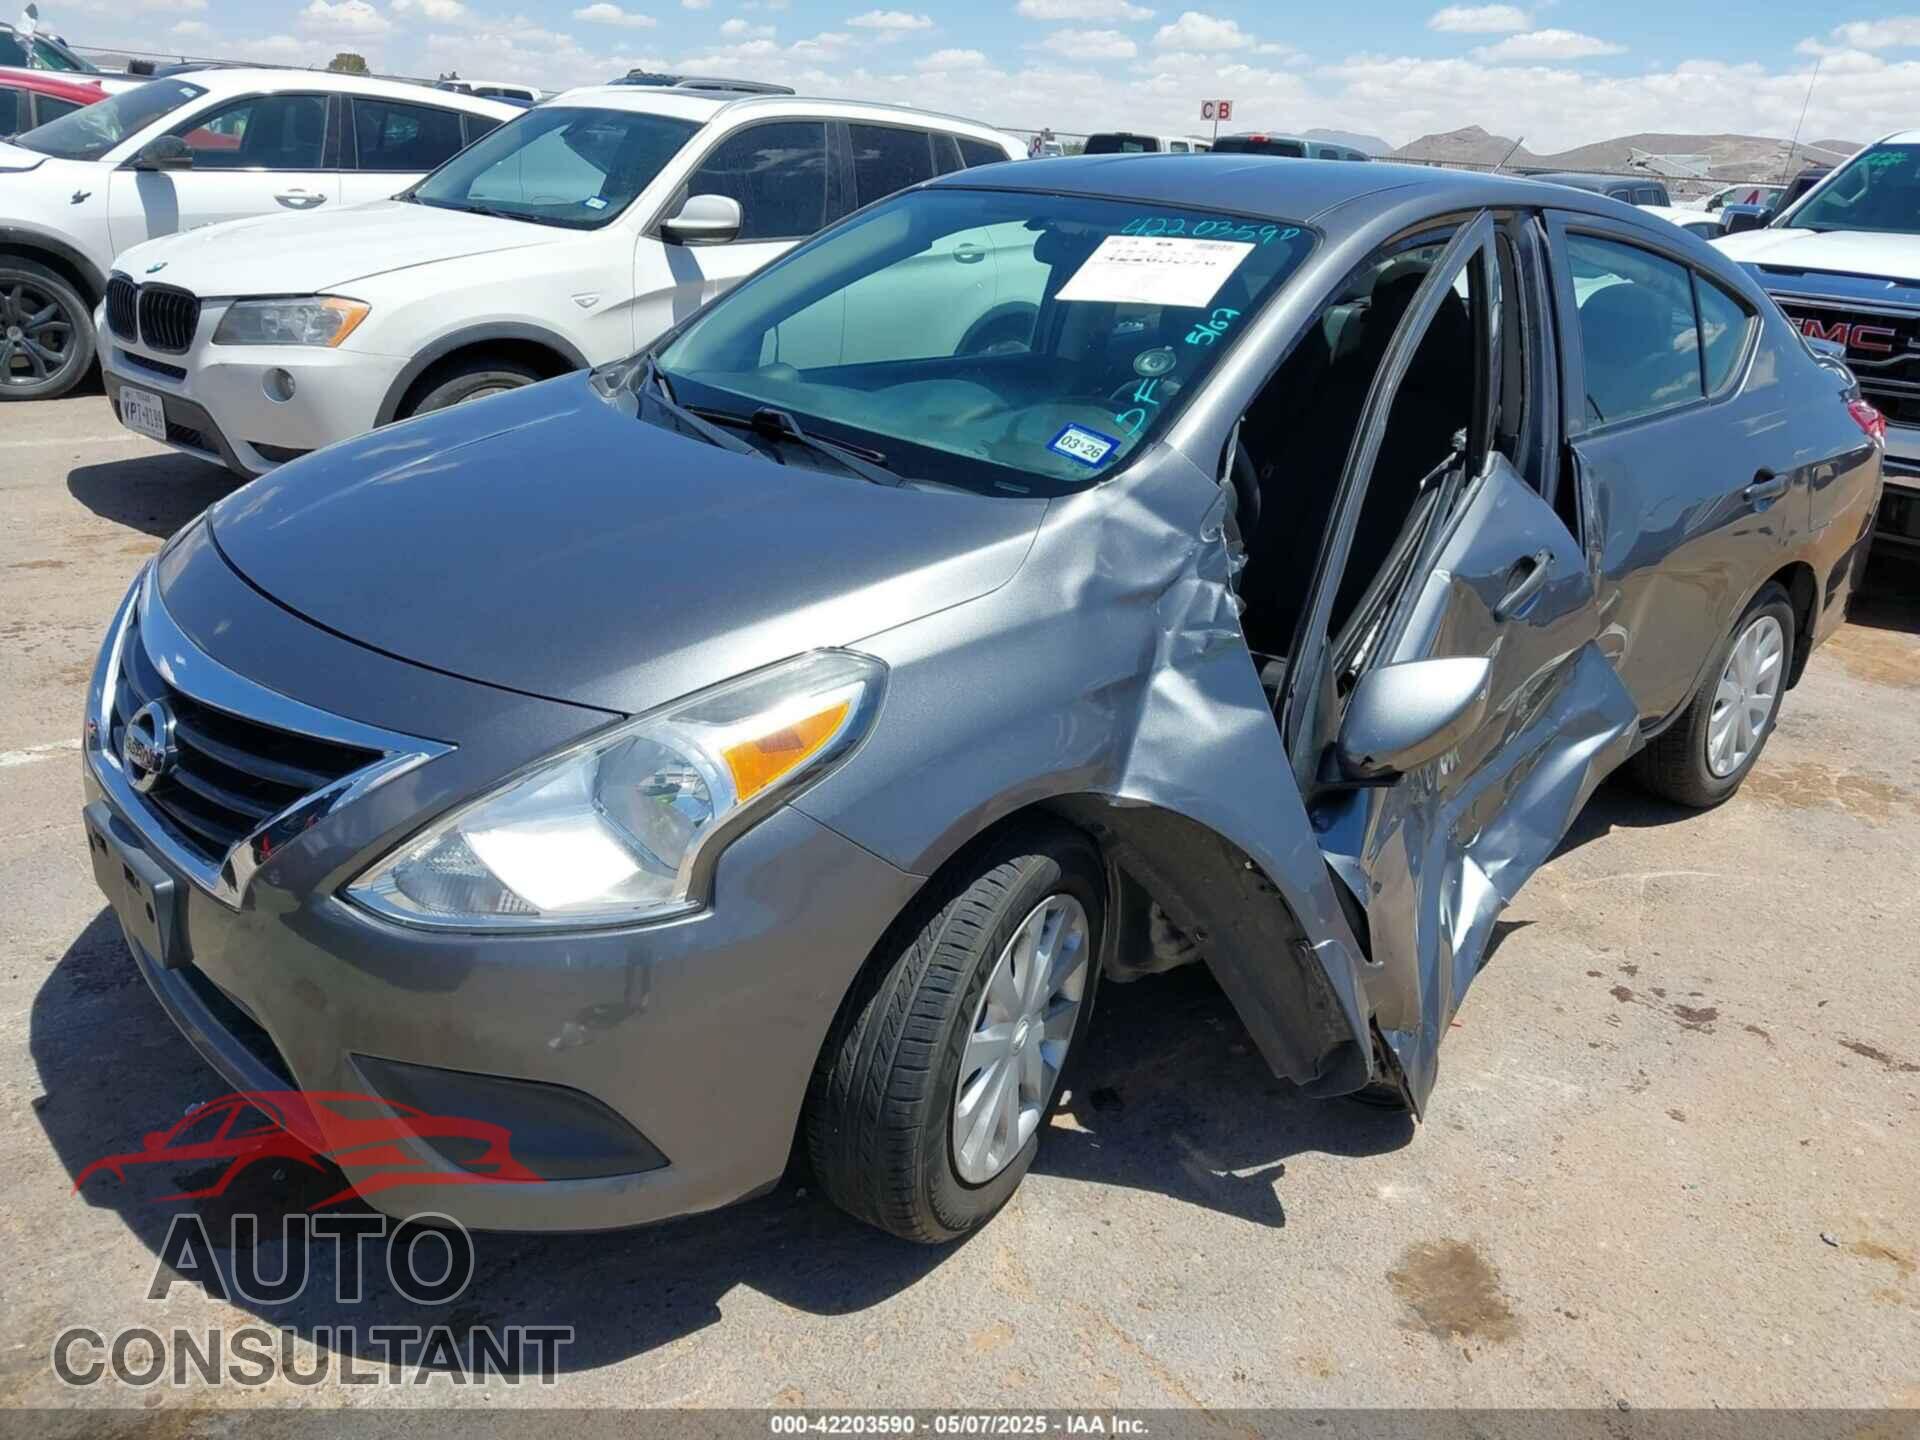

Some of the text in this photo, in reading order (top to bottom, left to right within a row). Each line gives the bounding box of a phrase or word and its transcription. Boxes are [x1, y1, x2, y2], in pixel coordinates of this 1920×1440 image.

[1203, 102, 1229, 119] C B
[1060, 435, 1104, 458] 03 26
